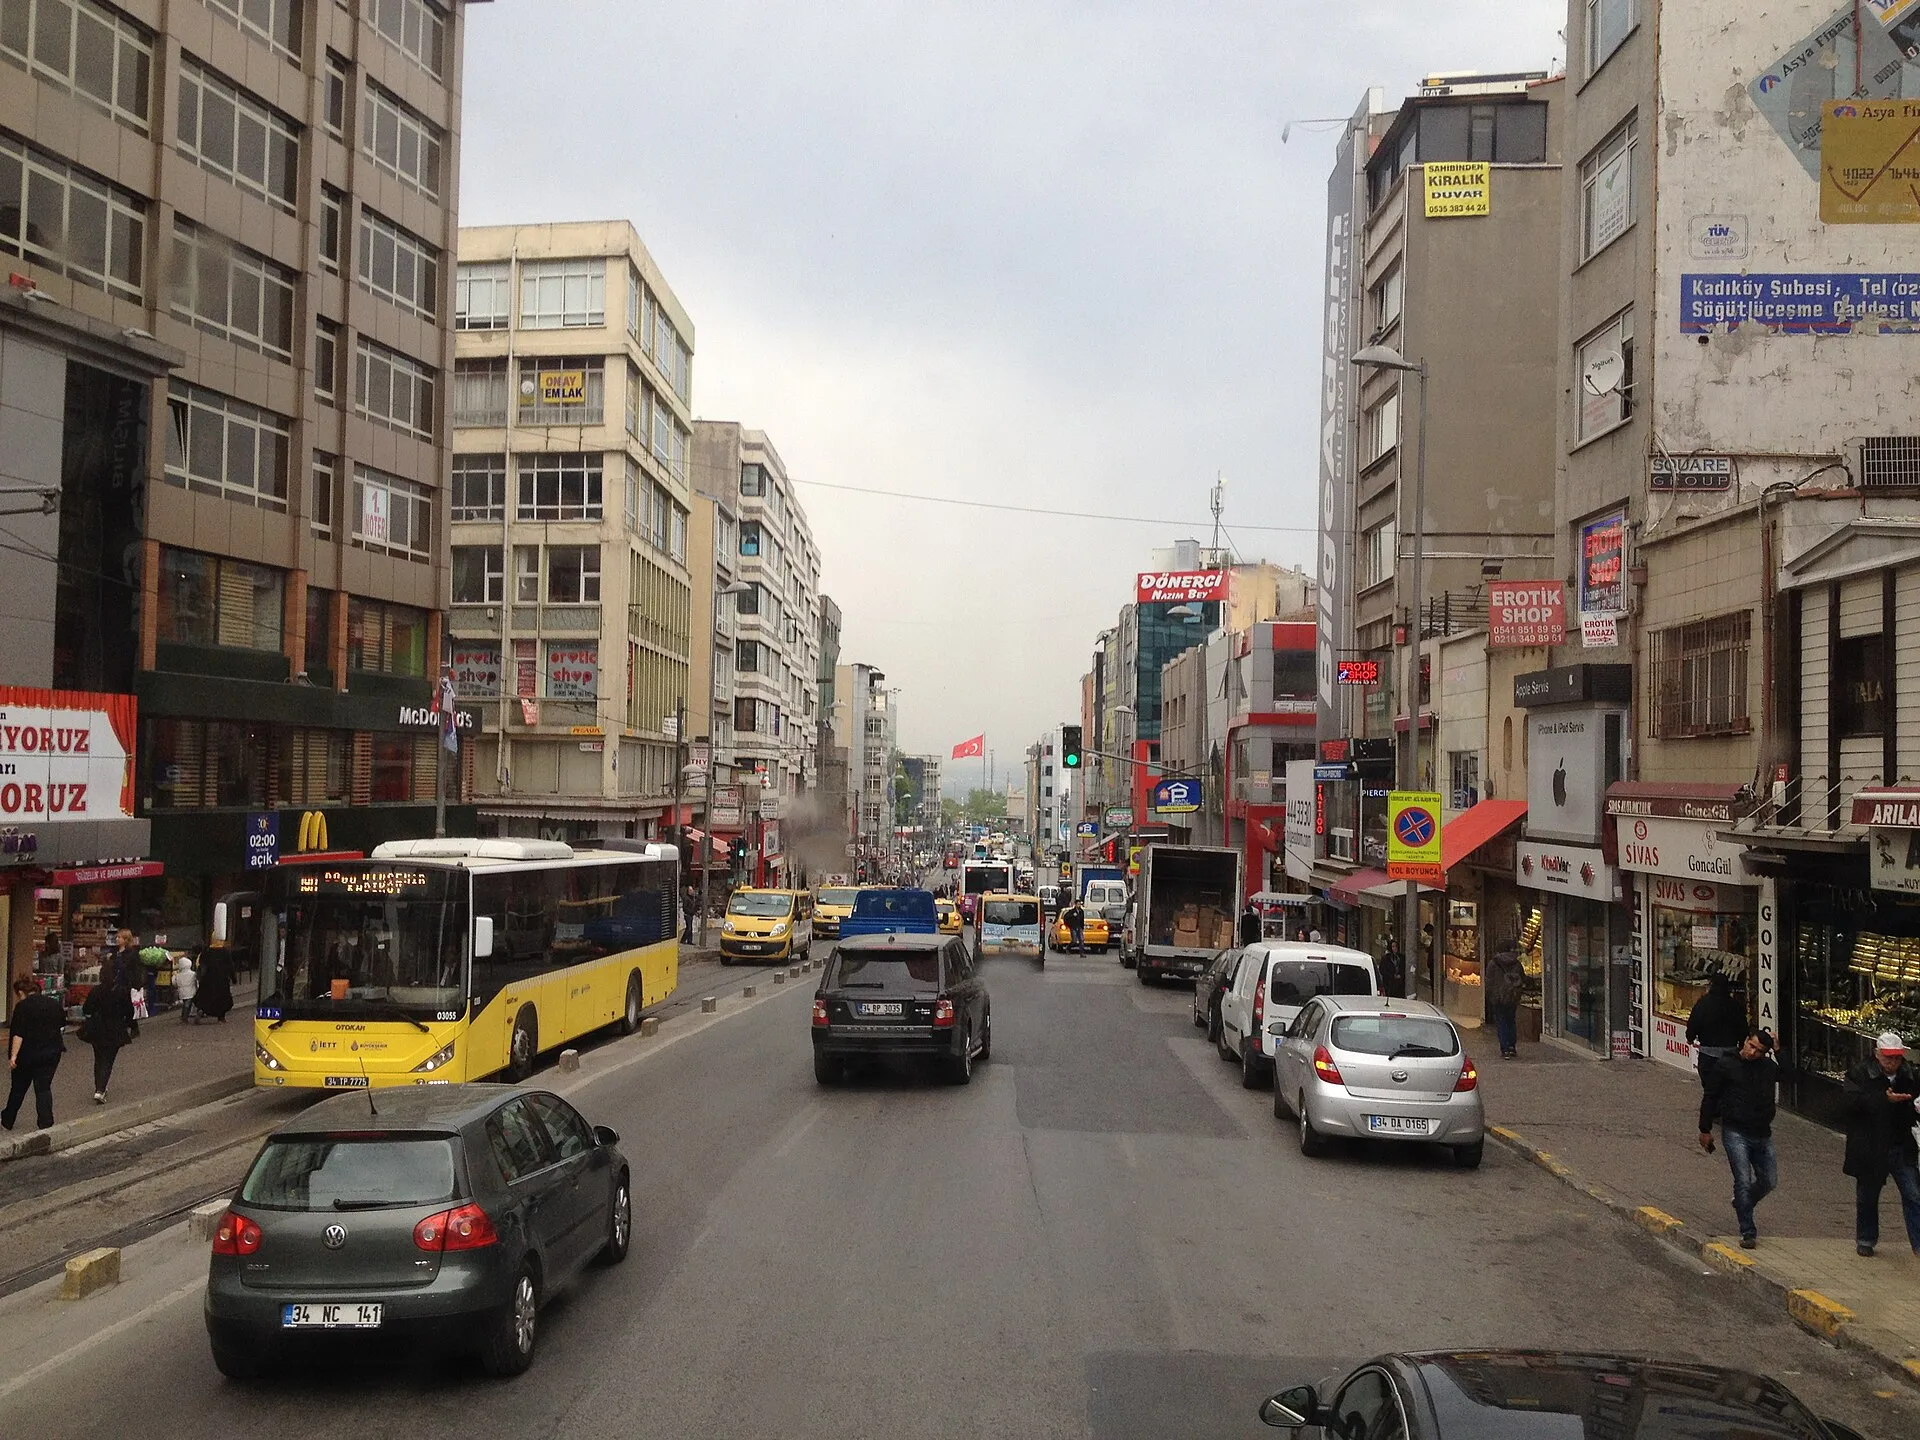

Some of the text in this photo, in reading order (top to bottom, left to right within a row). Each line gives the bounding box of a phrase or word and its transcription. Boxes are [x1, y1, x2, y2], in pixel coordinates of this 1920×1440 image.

[1781, 47, 1815, 78] Asya
[1862, 106, 1896, 121] Asya
[1842, 167, 1875, 180] 4022
[1431, 190, 1483, 200] DUVAR
[1429, 203, 1486, 213] 0535 383 44 24
[1692, 279, 1764, 299] Kadıköy
[1859, 278, 1887, 296] Tel
[545, 376, 577, 388] ONAY
[545, 387, 583, 399] EMLAK
[1652, 458, 1729, 472] SQUARE
[1140, 571, 1224, 589] DÖNERCİ
[1492, 586, 1561, 606] EROTİK
[1502, 607, 1553, 623] SHOP
[1493, 624, 1562, 634] 0541 851 89 59
[1584, 619, 1614, 628] EROTİK
[1494, 633, 1562, 643] 0216 349 89 61
[1339, 660, 1378, 671] EROTİK
[1347, 670, 1377, 679] SHOP
[1531, 679, 1550, 695] Servis
[399, 706, 474, 728] McDod's
[1871, 803, 1920, 826] ARILA
[249, 834, 276, 848] 02:00
[250, 852, 273, 868] açık
[1625, 843, 1659, 867] SİVAS
[1391, 866, 1439, 876] YOL BOYUNCA
[1688, 854, 1732, 876] GoncaGül
[1655, 876, 1685, 902] SİVAS
[437, 1011, 457, 1020] 03055
[1656, 1020, 1677, 1038] ALTIN
[1665, 1038, 1690, 1058] ALINIR
[1376, 1117, 1427, 1130] 34 DA 0165
[292, 1305, 379, 1323] 34 NC 141
